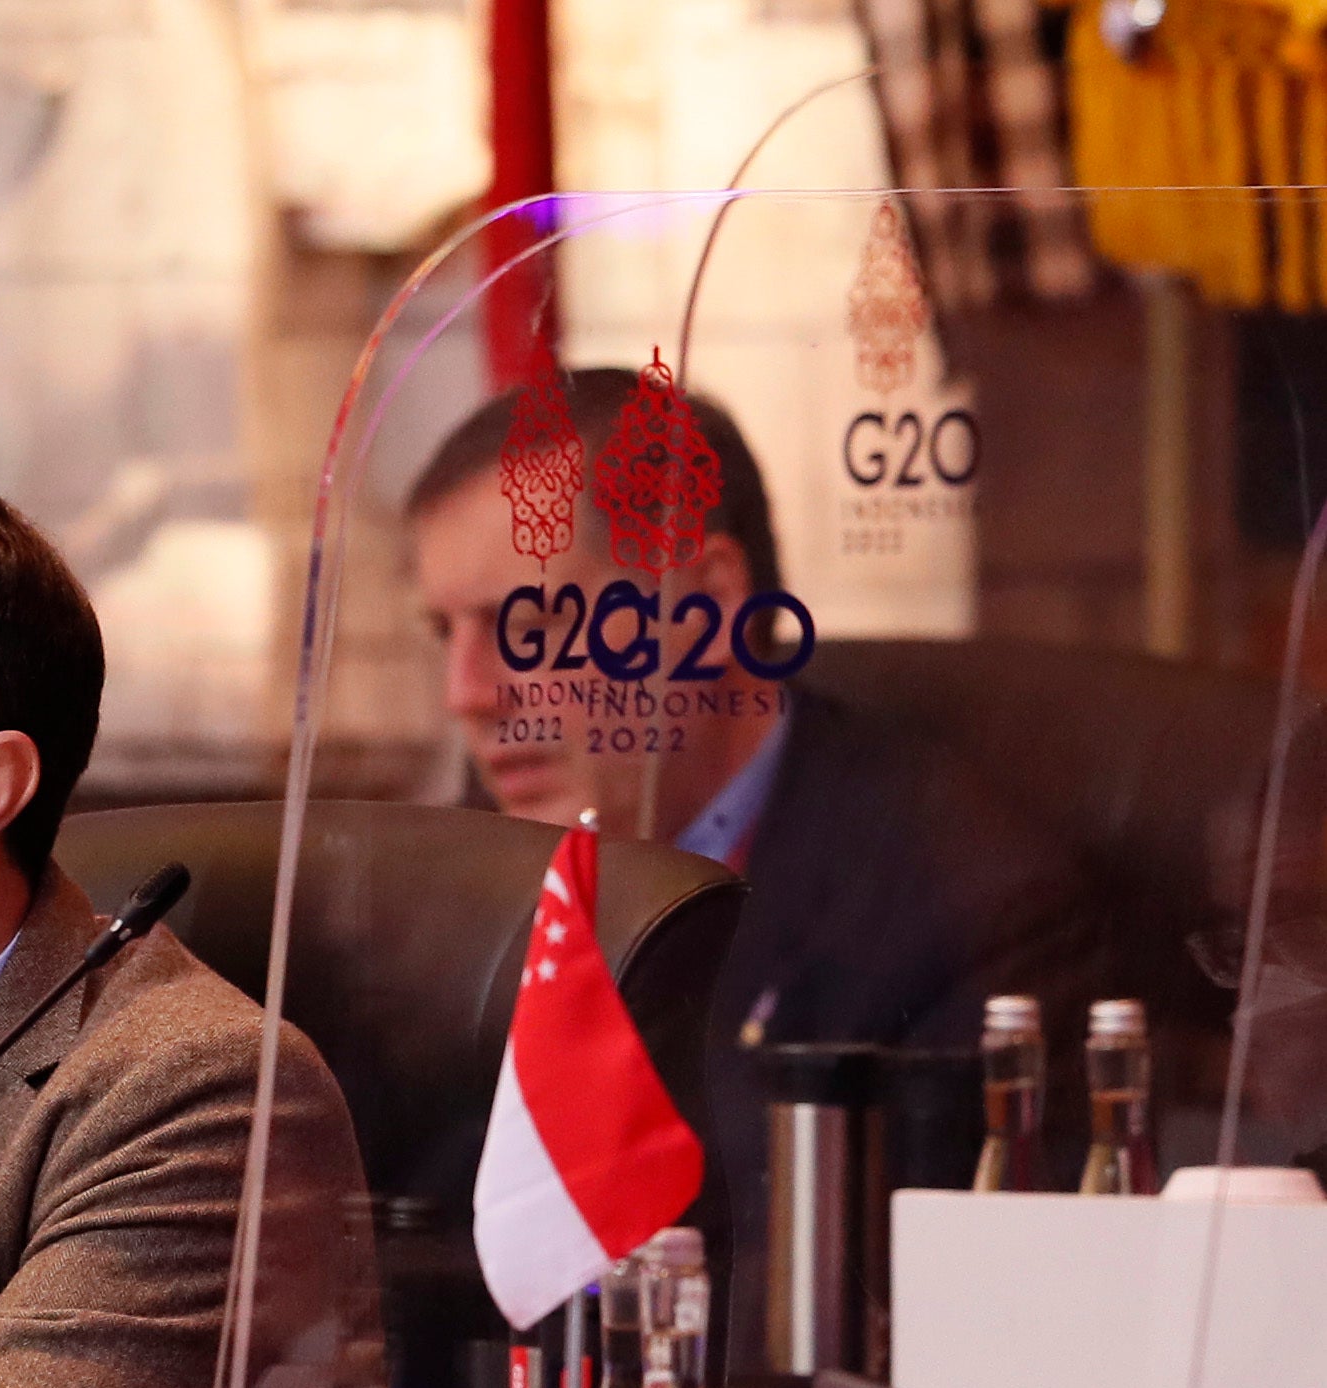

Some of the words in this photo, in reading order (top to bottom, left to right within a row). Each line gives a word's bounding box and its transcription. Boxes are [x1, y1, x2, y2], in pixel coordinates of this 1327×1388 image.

[844, 409, 981, 487] G20
[497, 579, 646, 672] G20
[588, 589, 816, 682] G20
[498, 716, 563, 744] 2022
[587, 688, 787, 719] INDONESI
[587, 726, 686, 754] 2022
